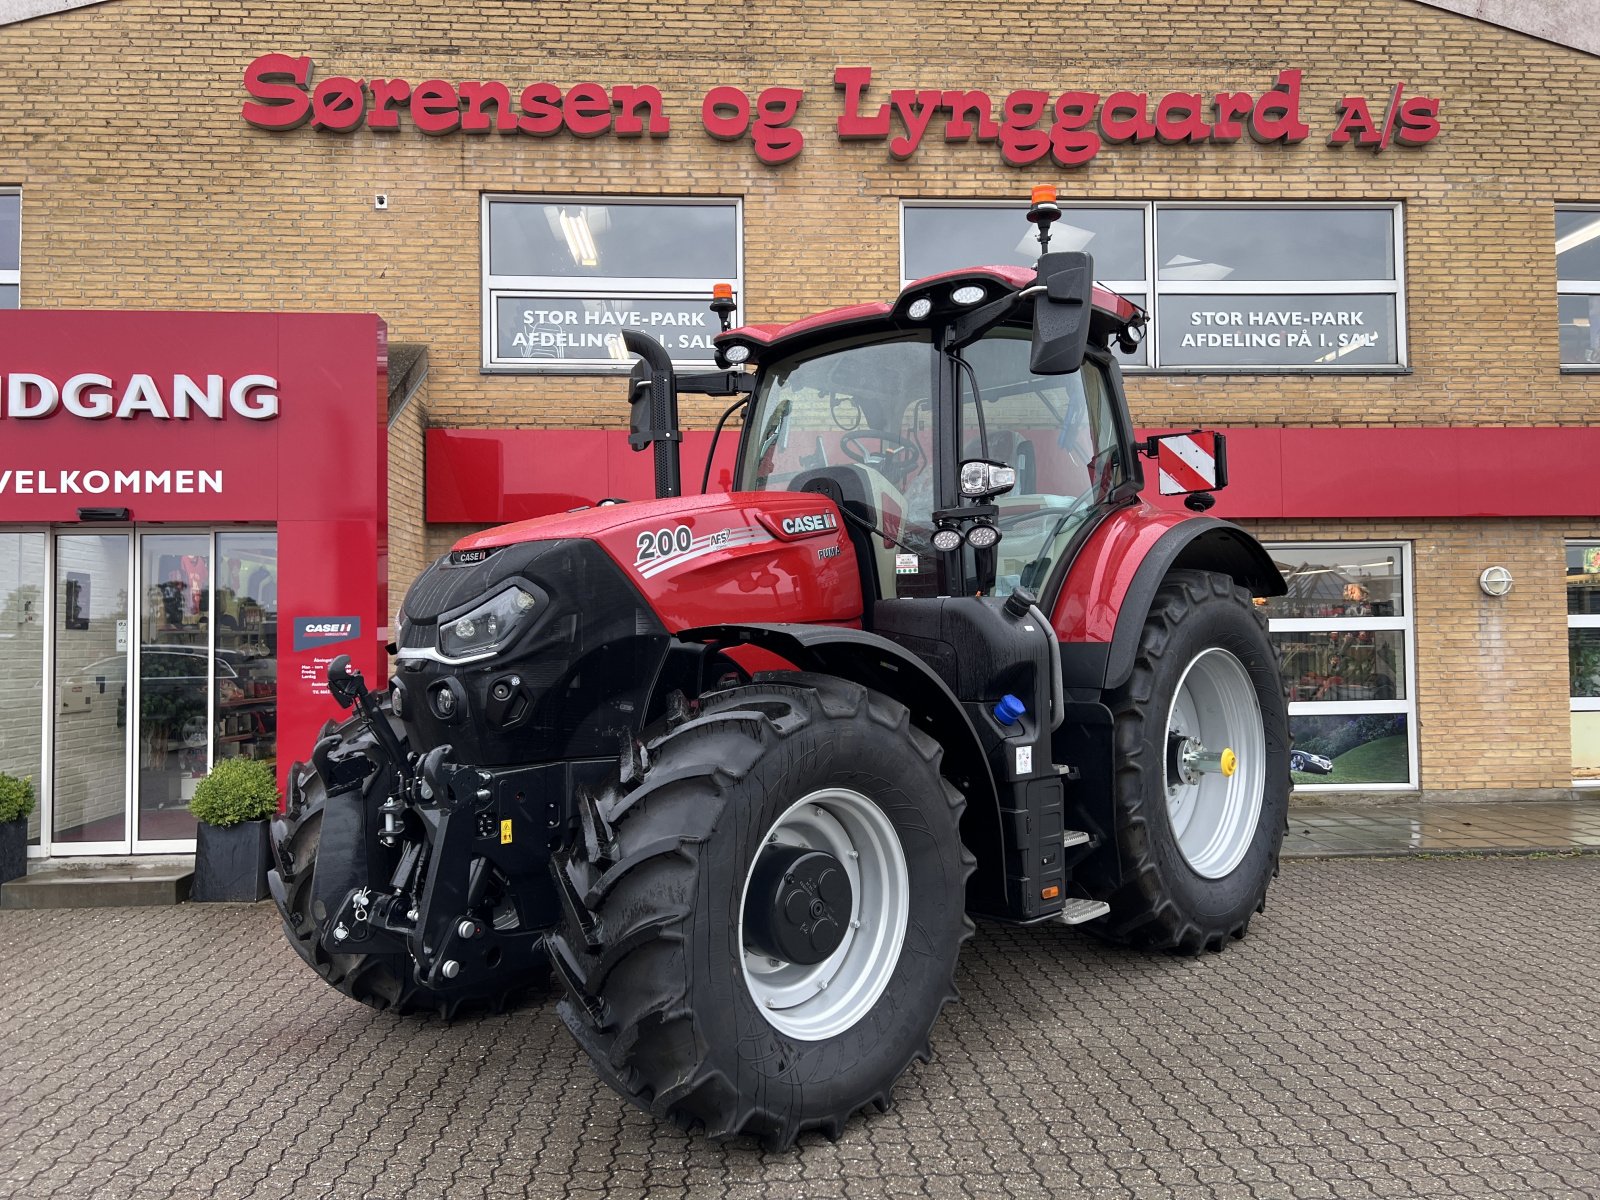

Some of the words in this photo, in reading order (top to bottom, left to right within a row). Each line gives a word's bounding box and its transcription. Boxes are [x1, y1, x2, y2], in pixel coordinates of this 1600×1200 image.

[242, 53, 670, 137] Sørensen
[703, 86, 804, 166] og
[834, 67, 1310, 169] Lynggaard
[523, 310, 579, 325] STOR
[584, 311, 706, 327] HAVE-PARK
[1191, 312, 1244, 326] STOR
[1248, 311, 1365, 326] HAVE-PARK
[1181, 333, 1281, 347] AFDELING
[1286, 328, 1313, 348] PÅ
[1338, 333, 1376, 347] SAL
[0, 373, 279, 419] DGANG
[782, 514, 824, 534] CASE
[636, 525, 693, 561] 200
[709, 529, 730, 546] AFS
[460, 552, 479, 562] CASE
[817, 545, 841, 561] PUMA
[305, 623, 340, 633] CASE
